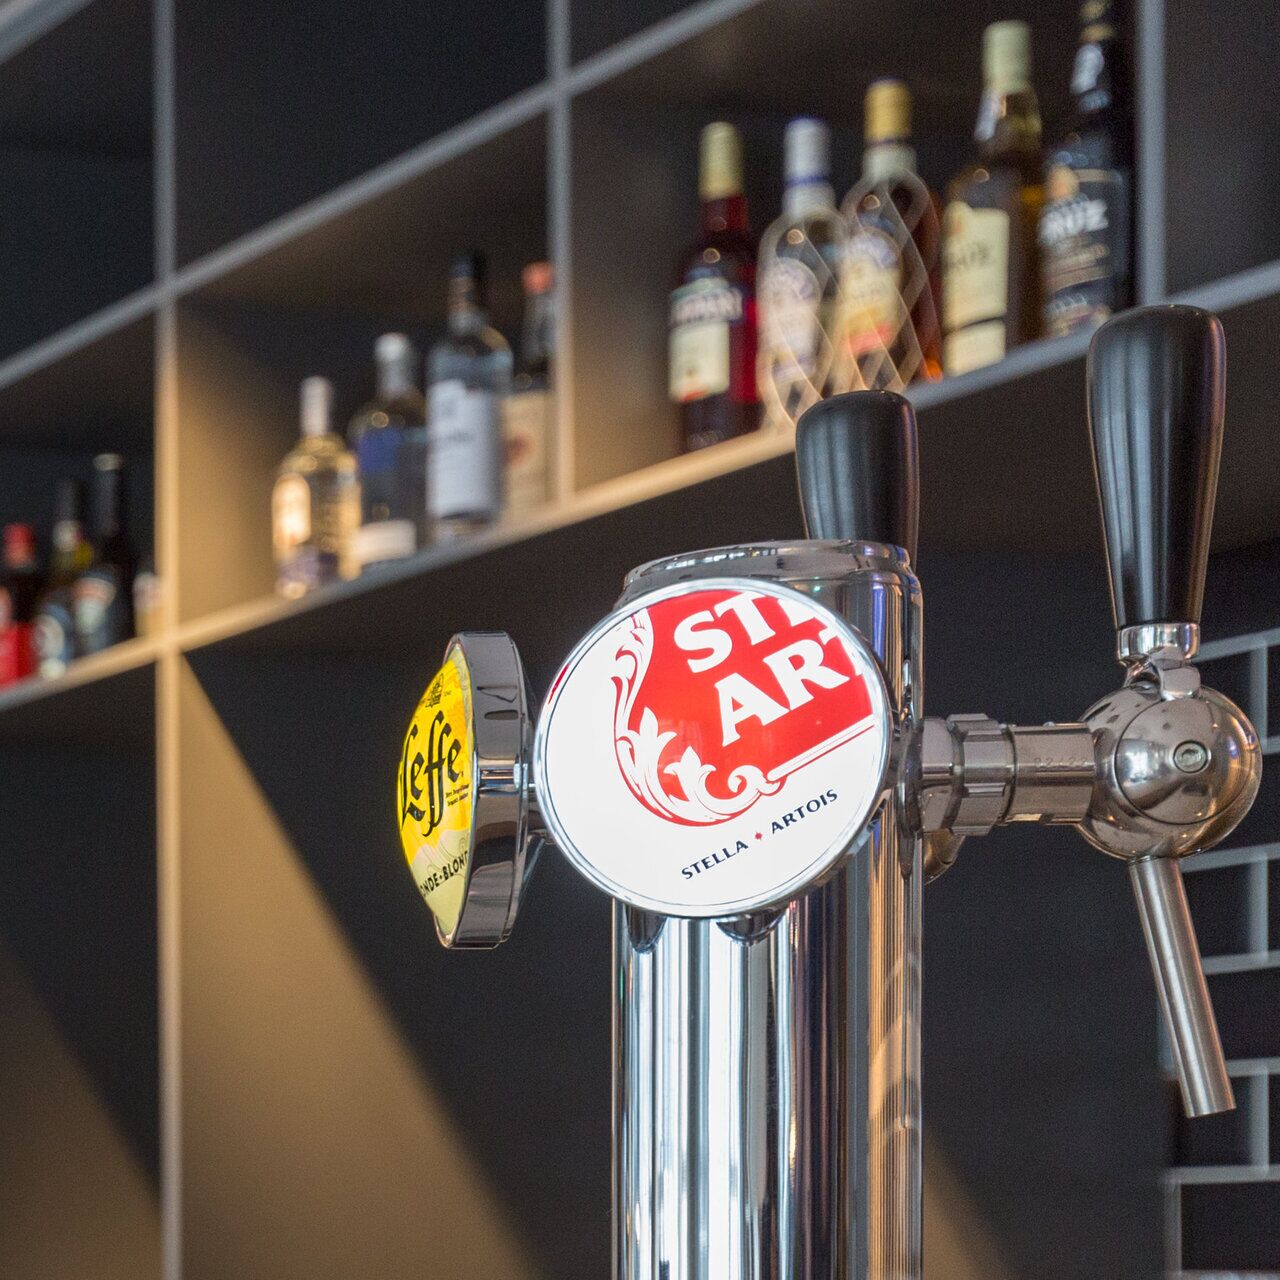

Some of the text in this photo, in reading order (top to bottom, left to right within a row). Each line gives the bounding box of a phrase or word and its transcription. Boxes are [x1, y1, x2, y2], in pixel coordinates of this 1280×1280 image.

[400, 710, 462, 838] Leffe
[681, 788, 838, 880] STELLA ARTOIS
